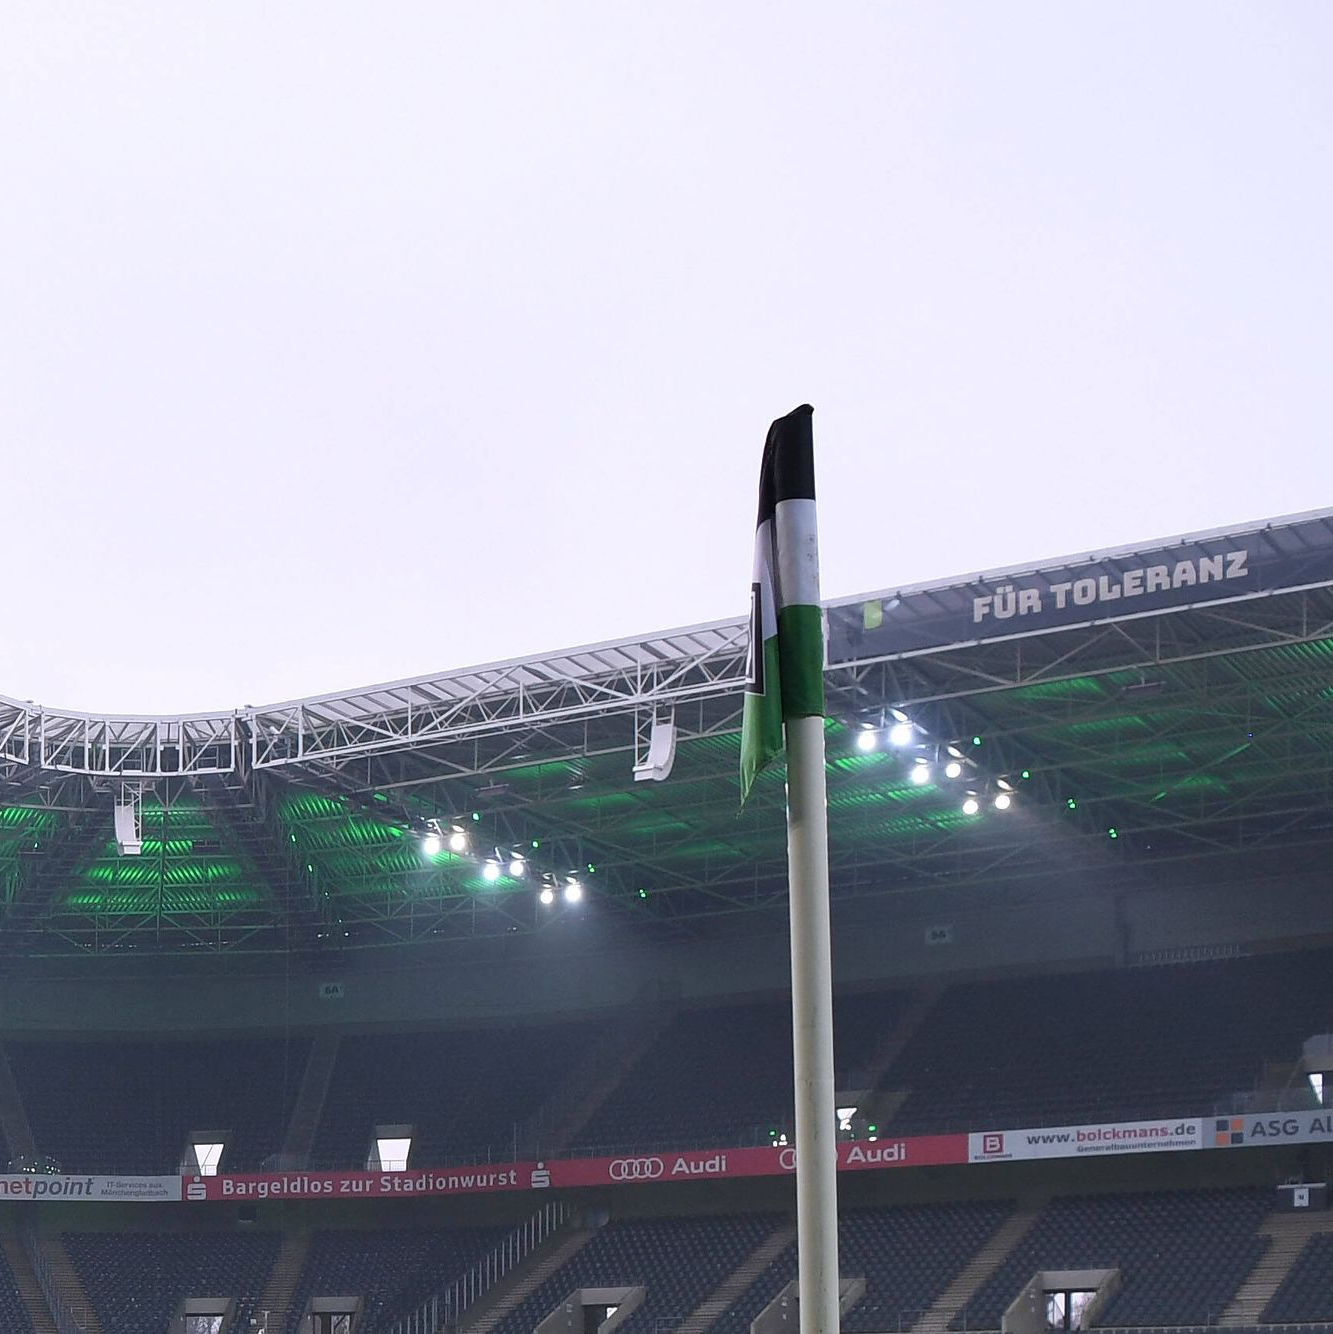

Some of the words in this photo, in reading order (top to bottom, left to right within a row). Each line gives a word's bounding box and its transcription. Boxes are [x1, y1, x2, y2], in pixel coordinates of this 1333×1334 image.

[973, 585, 1042, 623] FÜR
[1050, 550, 1249, 609] TOLERANZ
[1027, 1122, 1196, 1145] www.bolckmans.de
[1251, 1119, 1299, 1137] ASG
[846, 1142, 906, 1163] Audi
[672, 1156, 726, 1175] Audi
[222, 1177, 333, 1198] Bargeldlos
[340, 1179, 373, 1193] zur
[380, 1169, 517, 1192] Stadionwurst
